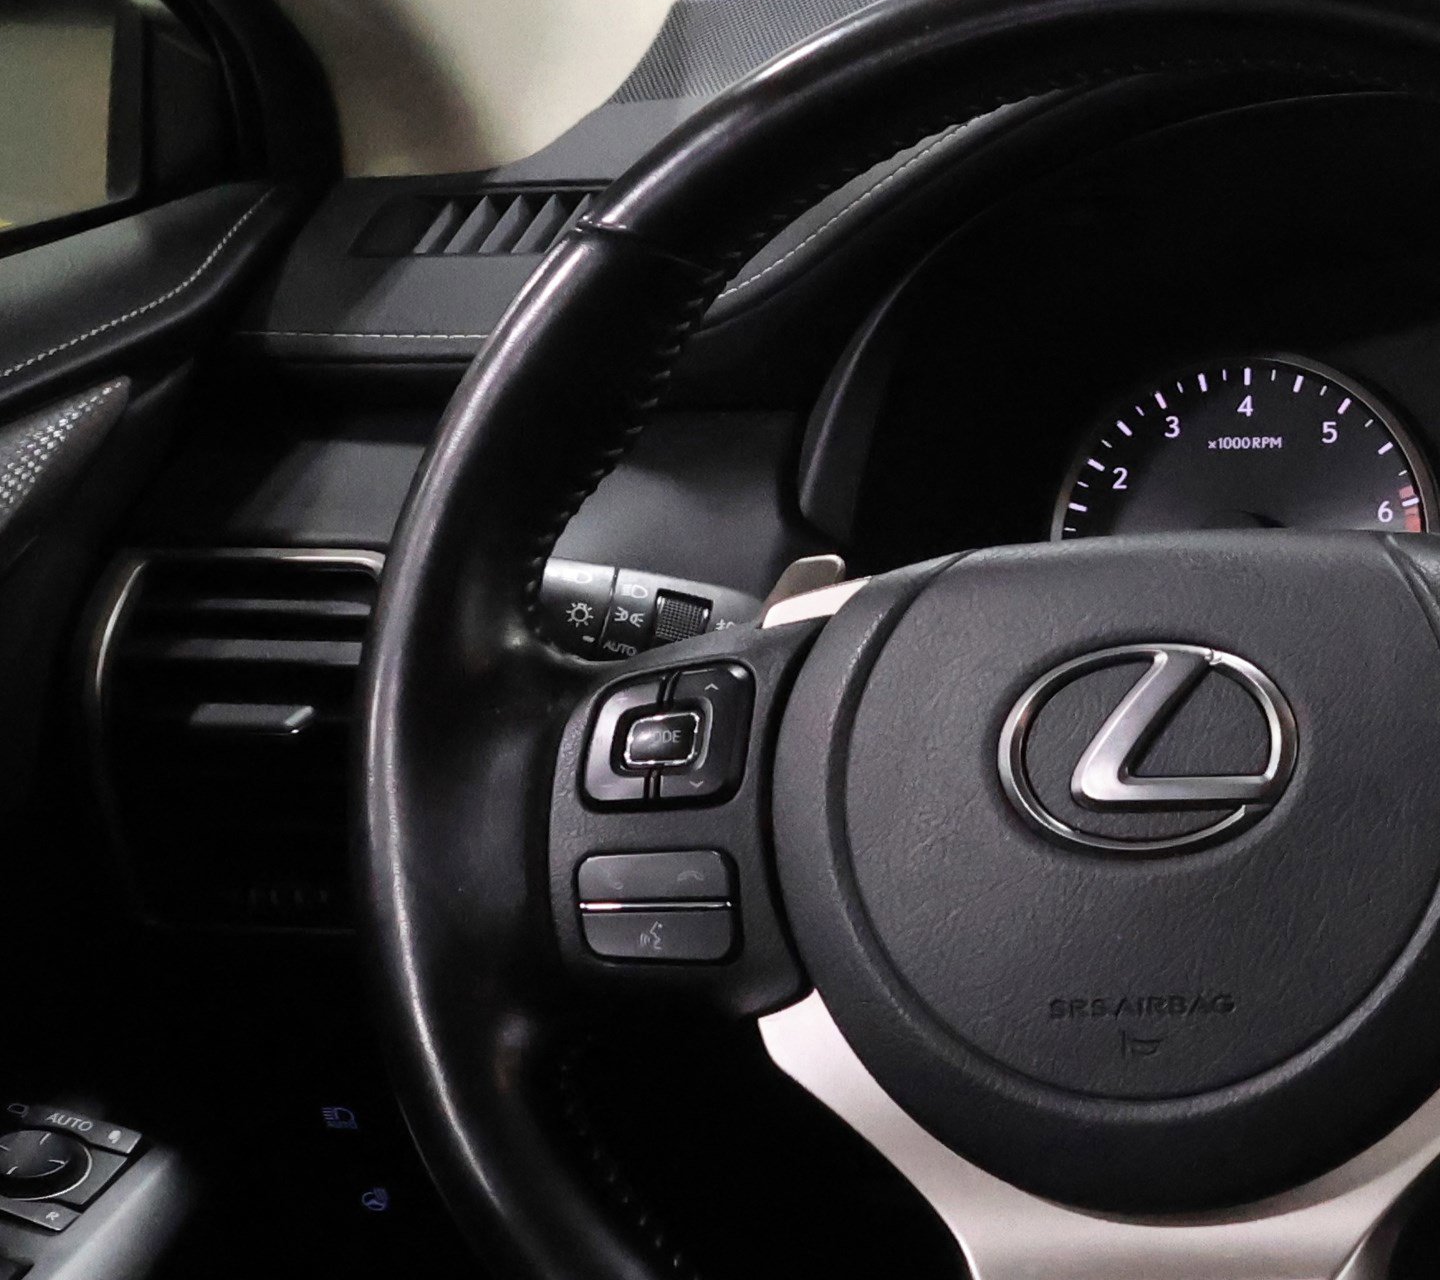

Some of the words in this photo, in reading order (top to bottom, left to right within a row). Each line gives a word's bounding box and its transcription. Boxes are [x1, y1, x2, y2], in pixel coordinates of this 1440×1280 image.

[1237, 396, 1253, 416] 4
[1165, 416, 1180, 438] 3
[1322, 422, 1337, 443] 5
[1113, 468, 1127, 489] 2
[1378, 501, 1393, 525] 6
[604, 639, 637, 657] AUTO
[47, 1112, 93, 1132] AUTO
[46, 1211, 59, 1222] R
